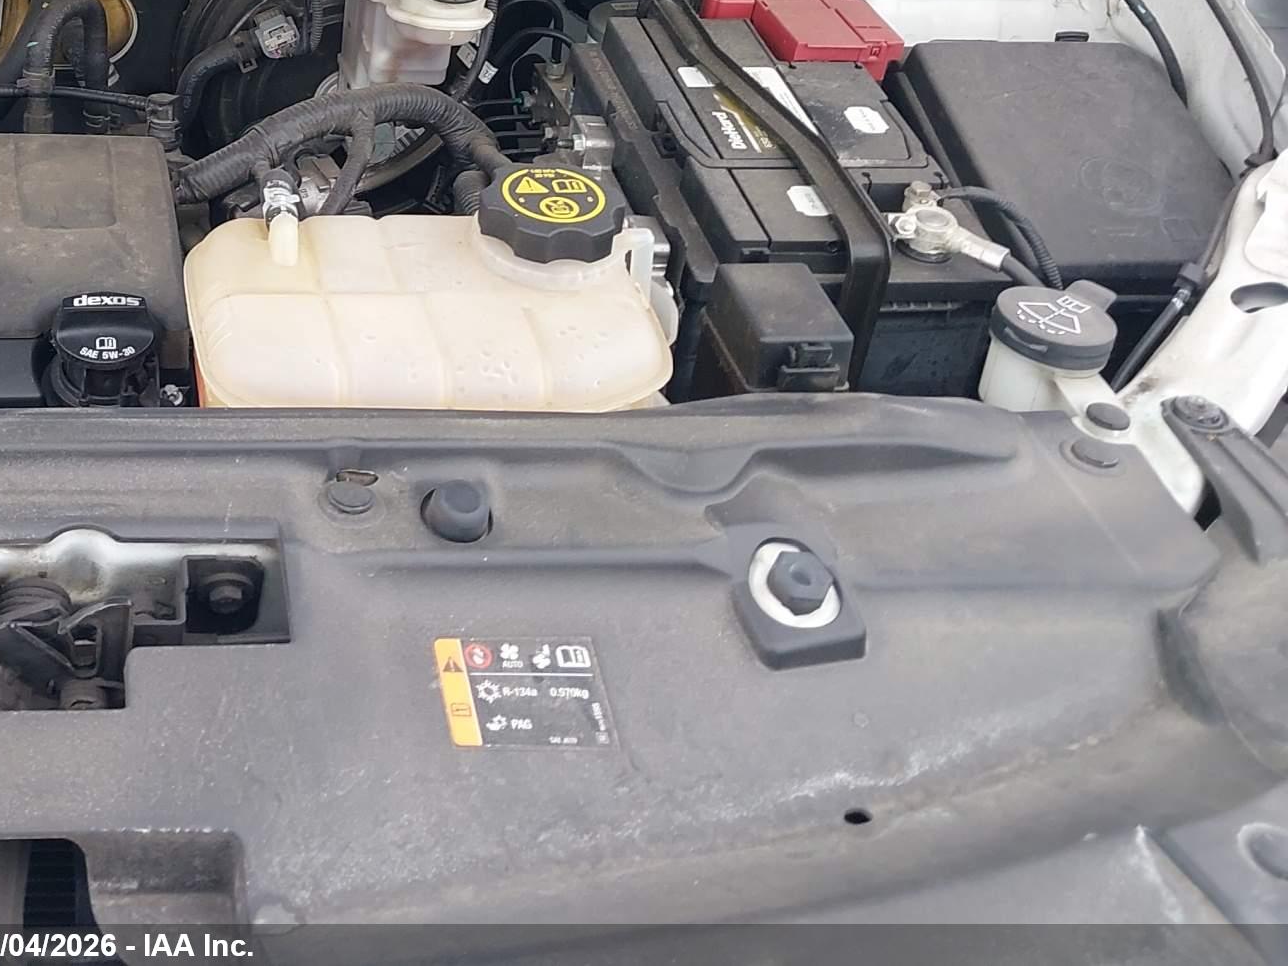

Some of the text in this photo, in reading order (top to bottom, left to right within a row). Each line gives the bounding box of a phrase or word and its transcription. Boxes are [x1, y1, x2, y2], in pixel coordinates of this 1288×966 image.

[712, 111, 748, 150] DieHard
[73, 295, 142, 307] dexos
[79, 346, 136, 360] SAE 5W-30
[502, 686, 538, 698] R-134a
